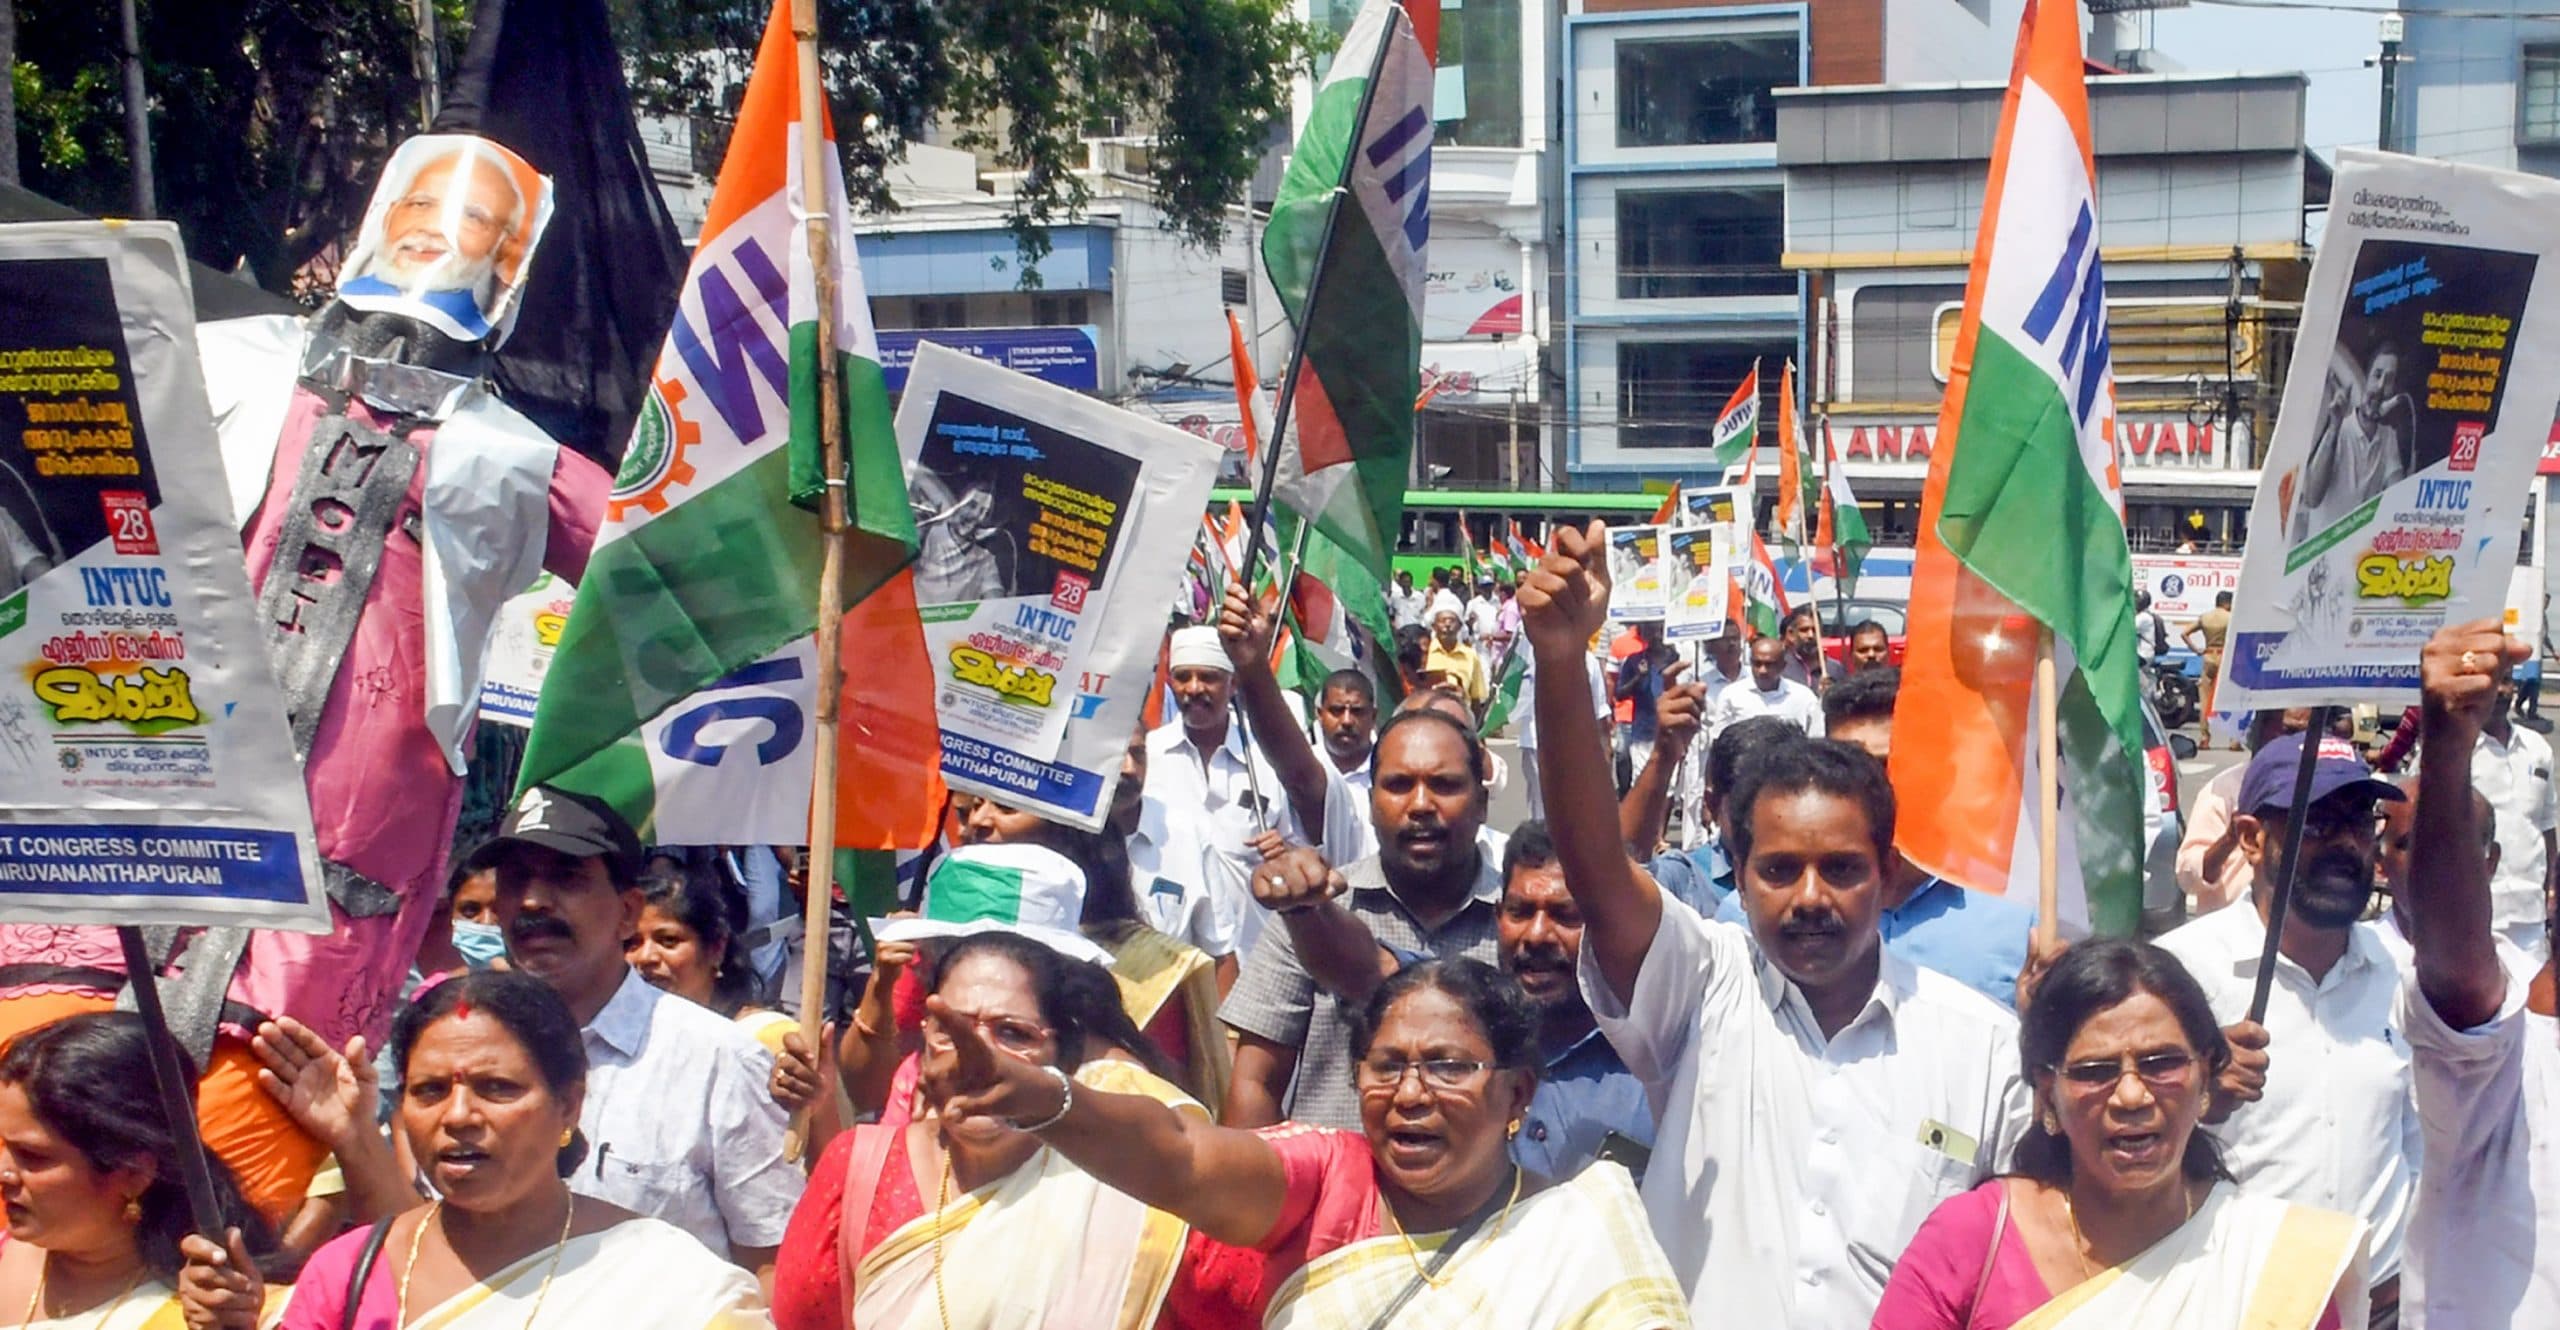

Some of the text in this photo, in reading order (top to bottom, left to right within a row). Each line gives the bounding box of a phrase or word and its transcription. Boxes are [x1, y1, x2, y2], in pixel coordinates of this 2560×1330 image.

[2118, 422, 2213, 454] VAN
[2454, 436, 2477, 460] 28
[2415, 478, 2471, 510] INTUC
[113, 508, 148, 540] 28
[276, 432, 388, 634] MODI
[80, 567, 171, 607] INTUC
[1056, 583, 1081, 604] 28
[1015, 603, 1077, 642] INTUC
[85, 748, 129, 759] INTUC
[993, 751, 1074, 787] COMMITTEE
[940, 751, 1039, 792] ANTHAPURAM
[0, 837, 262, 862] T CONGRESS COMMITTEE
[0, 861, 223, 886] IRUVANANTHAPURAM
